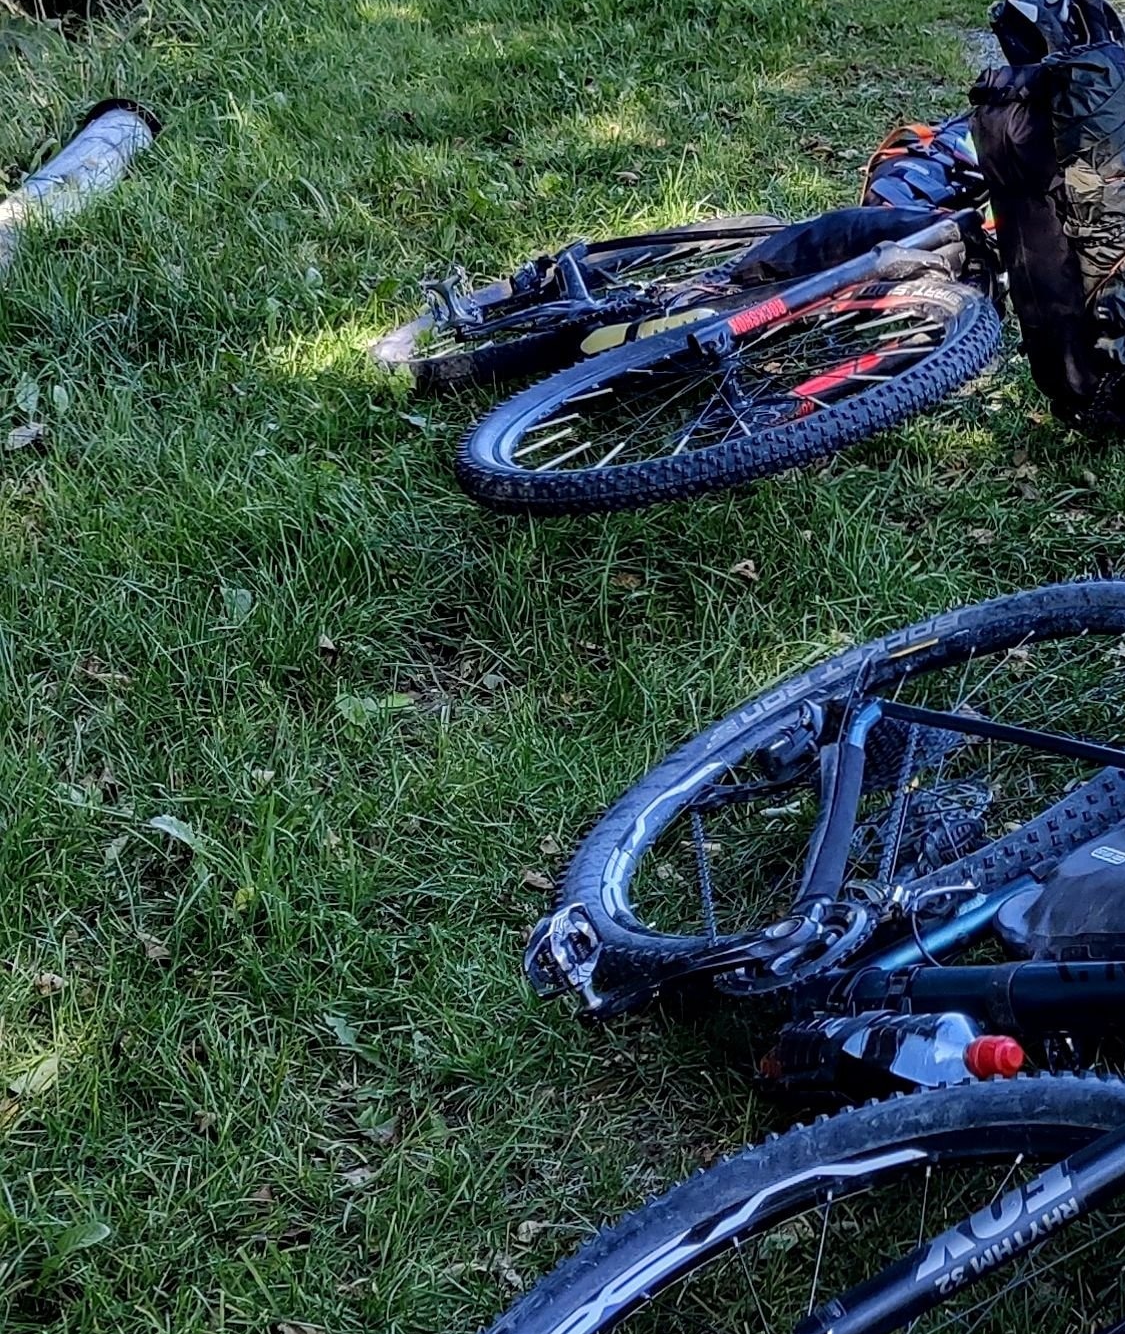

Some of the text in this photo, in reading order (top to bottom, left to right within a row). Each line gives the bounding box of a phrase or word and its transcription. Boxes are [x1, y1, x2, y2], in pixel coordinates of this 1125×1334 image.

[728, 297, 789, 336] ROCKSHOX
[739, 676, 814, 724] RON
[915, 1162, 1073, 1282] FOX
[934, 1196, 1080, 1295] RHYTHM 32
